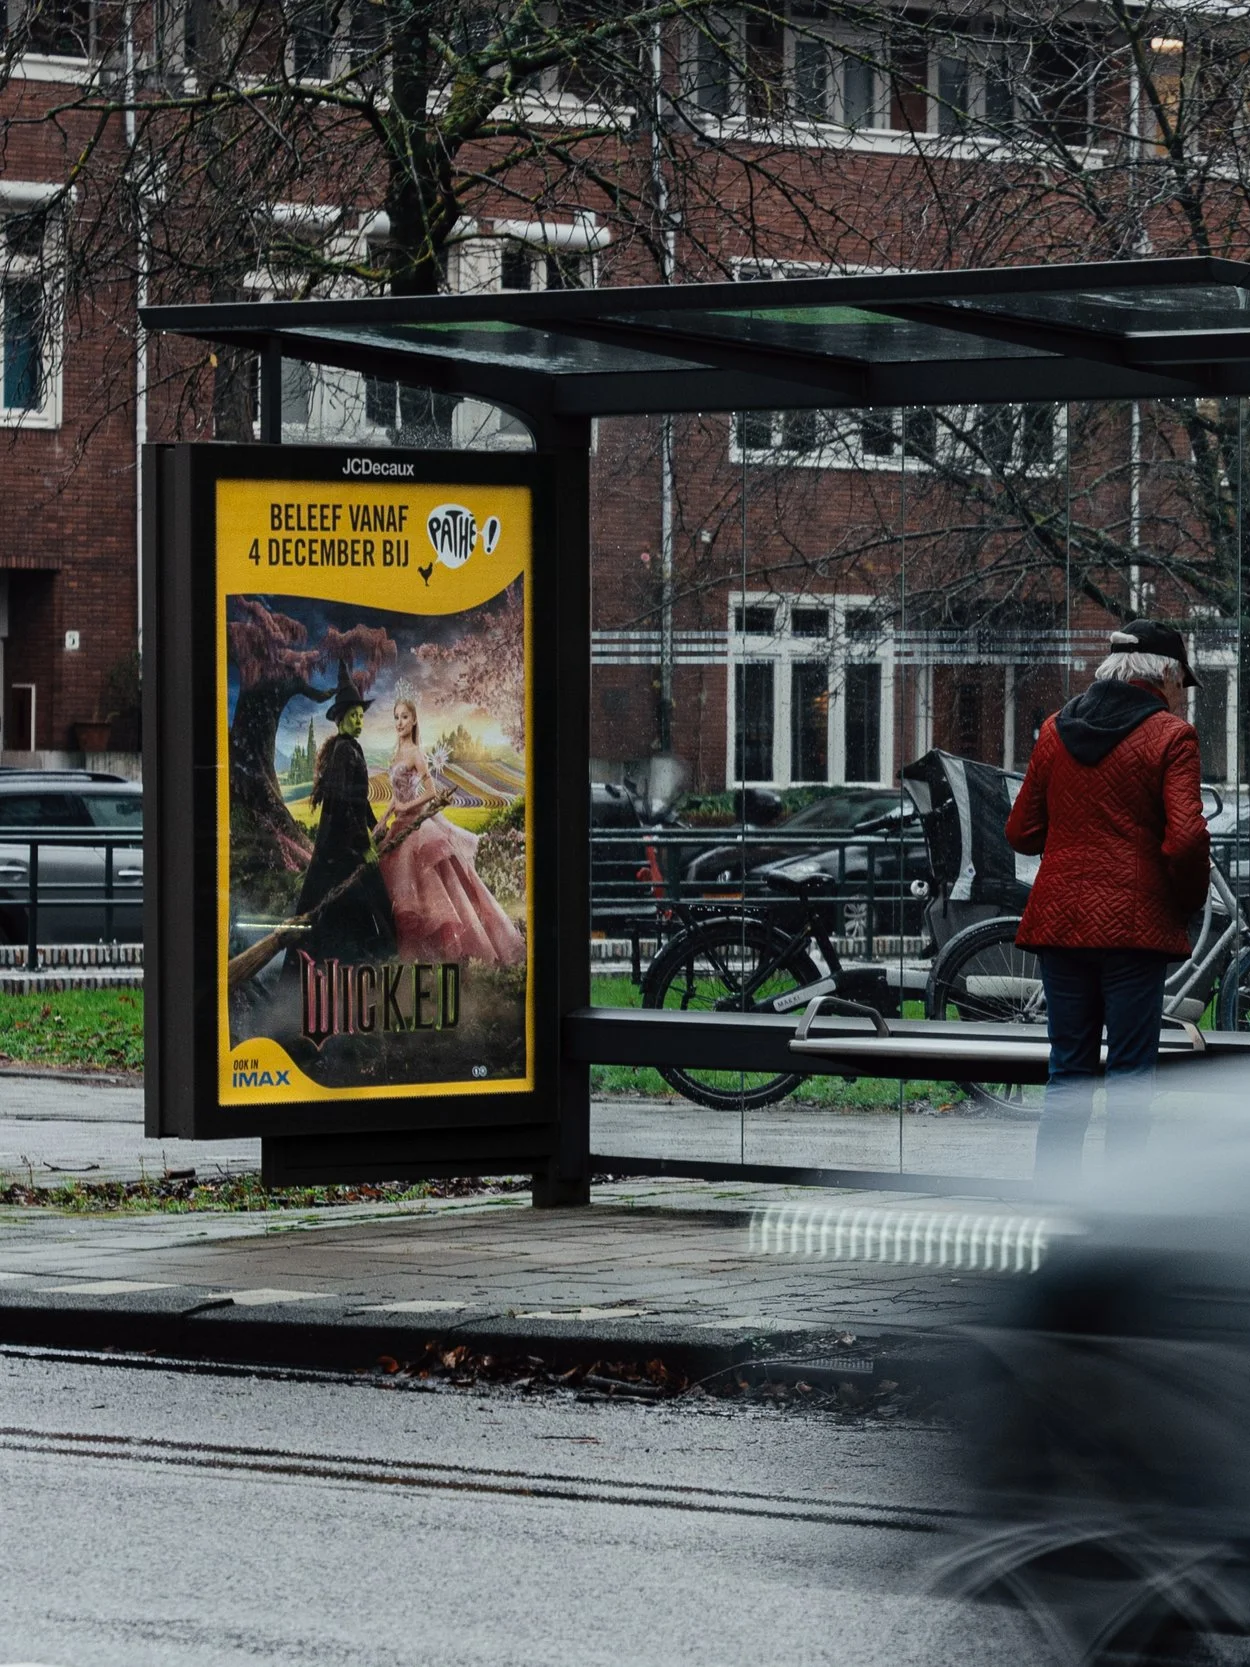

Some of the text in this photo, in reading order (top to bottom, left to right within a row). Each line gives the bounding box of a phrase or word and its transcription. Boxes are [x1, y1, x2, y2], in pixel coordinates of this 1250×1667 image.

[342, 458, 414, 477] JCDecaux
[270, 503, 410, 533] BELEEF VANAF
[248, 538, 410, 568] 4 DECEMBER BIJ
[298, 950, 461, 1052] WICKED
[233, 1058, 259, 1070] OOK IN
[232, 1070, 291, 1088] IMAX
